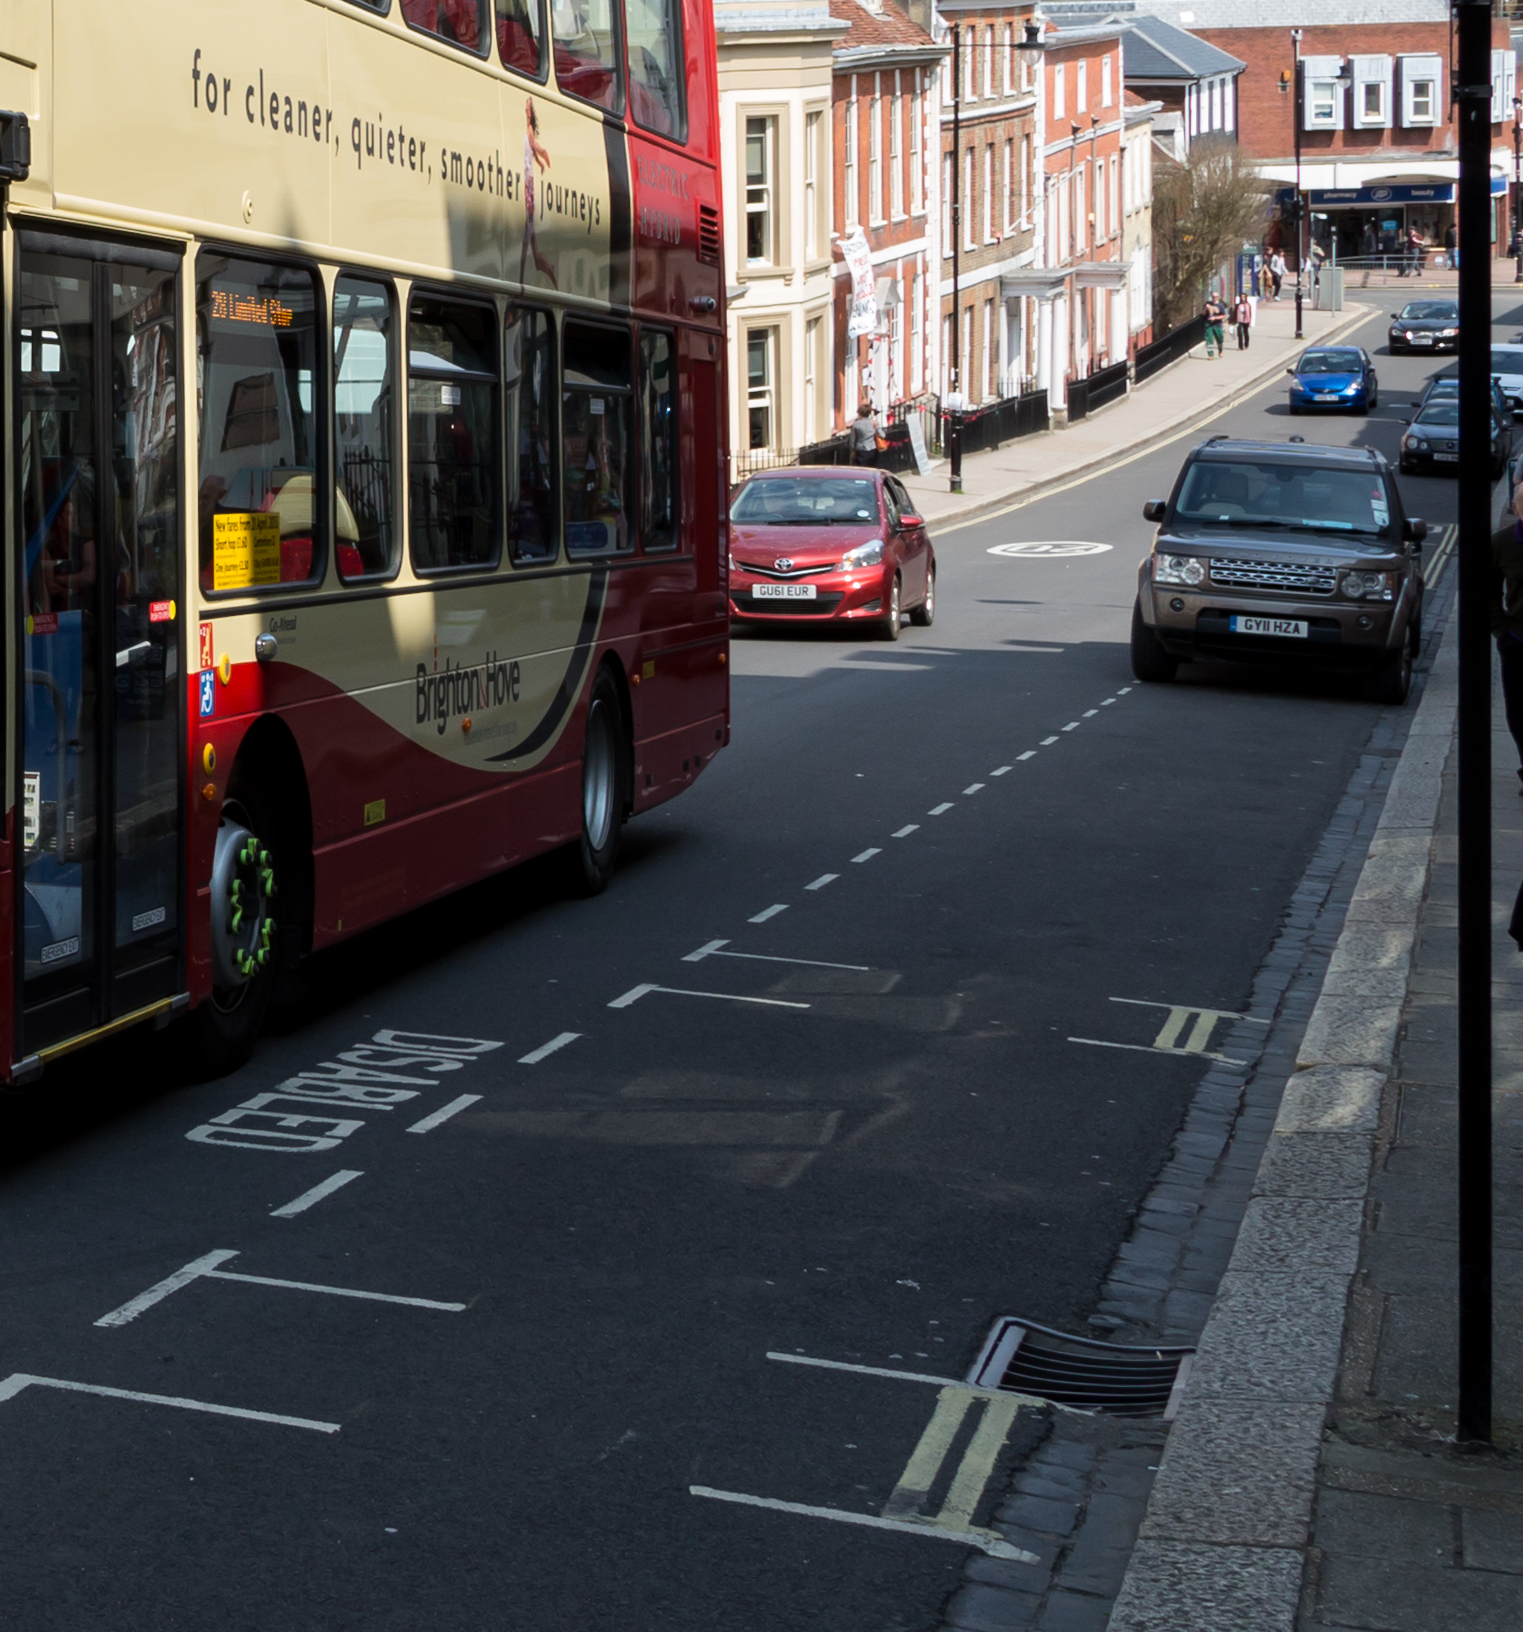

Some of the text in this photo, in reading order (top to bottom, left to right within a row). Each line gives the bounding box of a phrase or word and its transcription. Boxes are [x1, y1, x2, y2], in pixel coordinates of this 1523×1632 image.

[192, 48, 601, 235] for cleaner, quieter, smoother journeys
[637, 154, 689, 201] ELECTRIC
[640, 205, 681, 246] HYBRID
[759, 585, 809, 597] GU61 EUR
[1244, 618, 1300, 635] GY11 HZA
[184, 1029, 506, 1153] DISABLED
